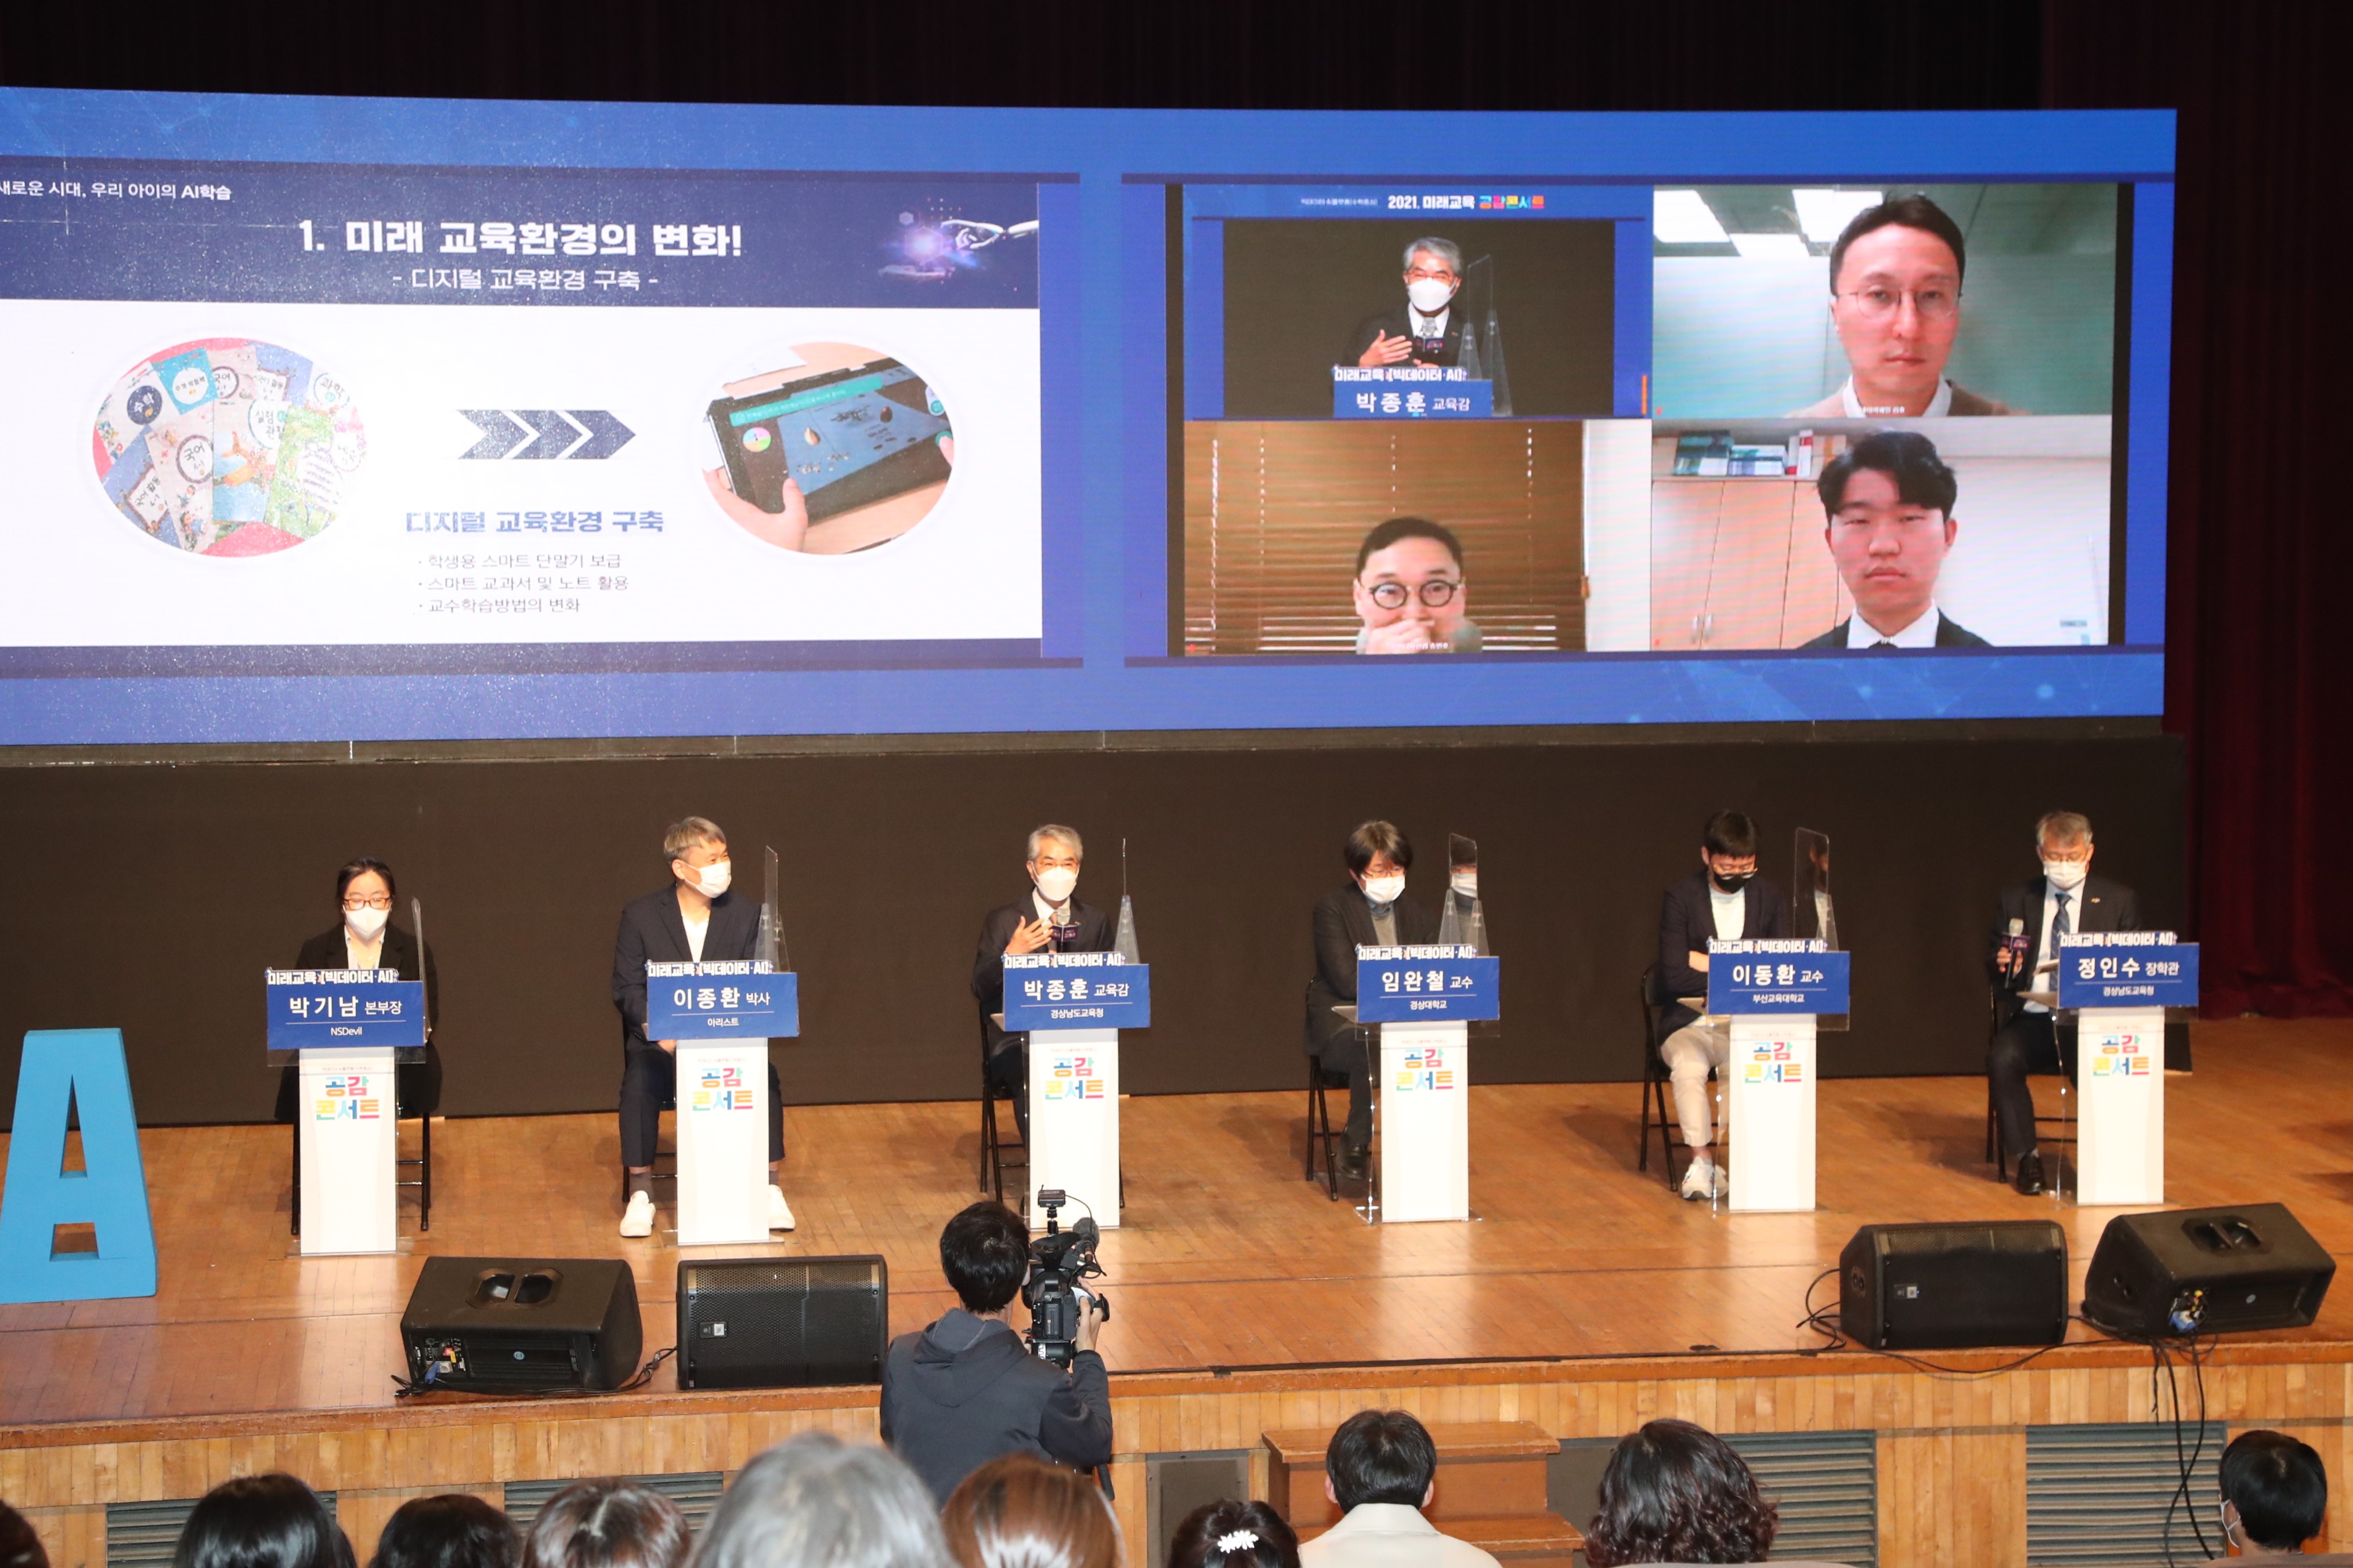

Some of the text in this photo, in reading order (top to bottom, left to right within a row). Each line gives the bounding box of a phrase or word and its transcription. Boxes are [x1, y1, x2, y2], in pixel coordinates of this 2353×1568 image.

[0, 180, 232, 200] 새로운 시대, 우리 아이의 AI학습
[1423, 195, 1475, 209] 미래교육
[299, 219, 742, 257] 1. 미래 교육환경의 변화!
[411, 269, 482, 289] 디지털
[490, 269, 586, 290] 교육환경
[594, 270, 641, 291] 구축
[1334, 368, 1385, 382] 미래교육
[1432, 397, 1470, 411] 교육감
[183, 442, 205, 461] 국어
[406, 510, 664, 533] 디지털 교육환경 구축
[428, 554, 621, 568] 학생용 스마트 단말기 보급
[427, 575, 629, 591] 스마트 교과서 및 노트 활용
[428, 597, 580, 613] 교수학습방법의 변화
[1709, 940, 1754, 954] 미래교육
[2060, 932, 2104, 948] 미래교육
[1358, 947, 1403, 961] 미래교육
[1004, 955, 1050, 969] 미래교육
[2145, 961, 2180, 976] 장학관
[648, 963, 695, 977] 미래교육
[1800, 970, 1824, 984] 교수
[268, 971, 317, 985] 미래교육
[1450, 976, 1473, 989] 교수
[1094, 983, 1130, 997] 교육감
[2103, 985, 2155, 997] 경상남도교육청
[746, 991, 771, 1006] 박사
[1410, 1000, 1447, 1011] 경상대학교
[1752, 994, 1805, 1004] 부산교육대학교
[364, 1001, 402, 1015] 본부장
[1050, 1008, 1104, 1019] 경상남도교육청
[707, 1017, 740, 1027] 아리스트
[331, 1026, 363, 1036] NSDevil
[1754, 1041, 1792, 1061] 공감
[2101, 1034, 2141, 1055] 공감
[1404, 1048, 1444, 1069] 공감
[1053, 1057, 1094, 1077] 공감
[1744, 1063, 1802, 1084] 콘서트
[2092, 1056, 2150, 1077] 콘서트
[701, 1067, 743, 1088] 공감
[1396, 1070, 1454, 1091] 콘서트
[326, 1076, 369, 1097] 공감
[1044, 1080, 1104, 1100] 콘서트
[692, 1090, 754, 1111] 콘서트
[315, 1099, 380, 1121] 콘서트
